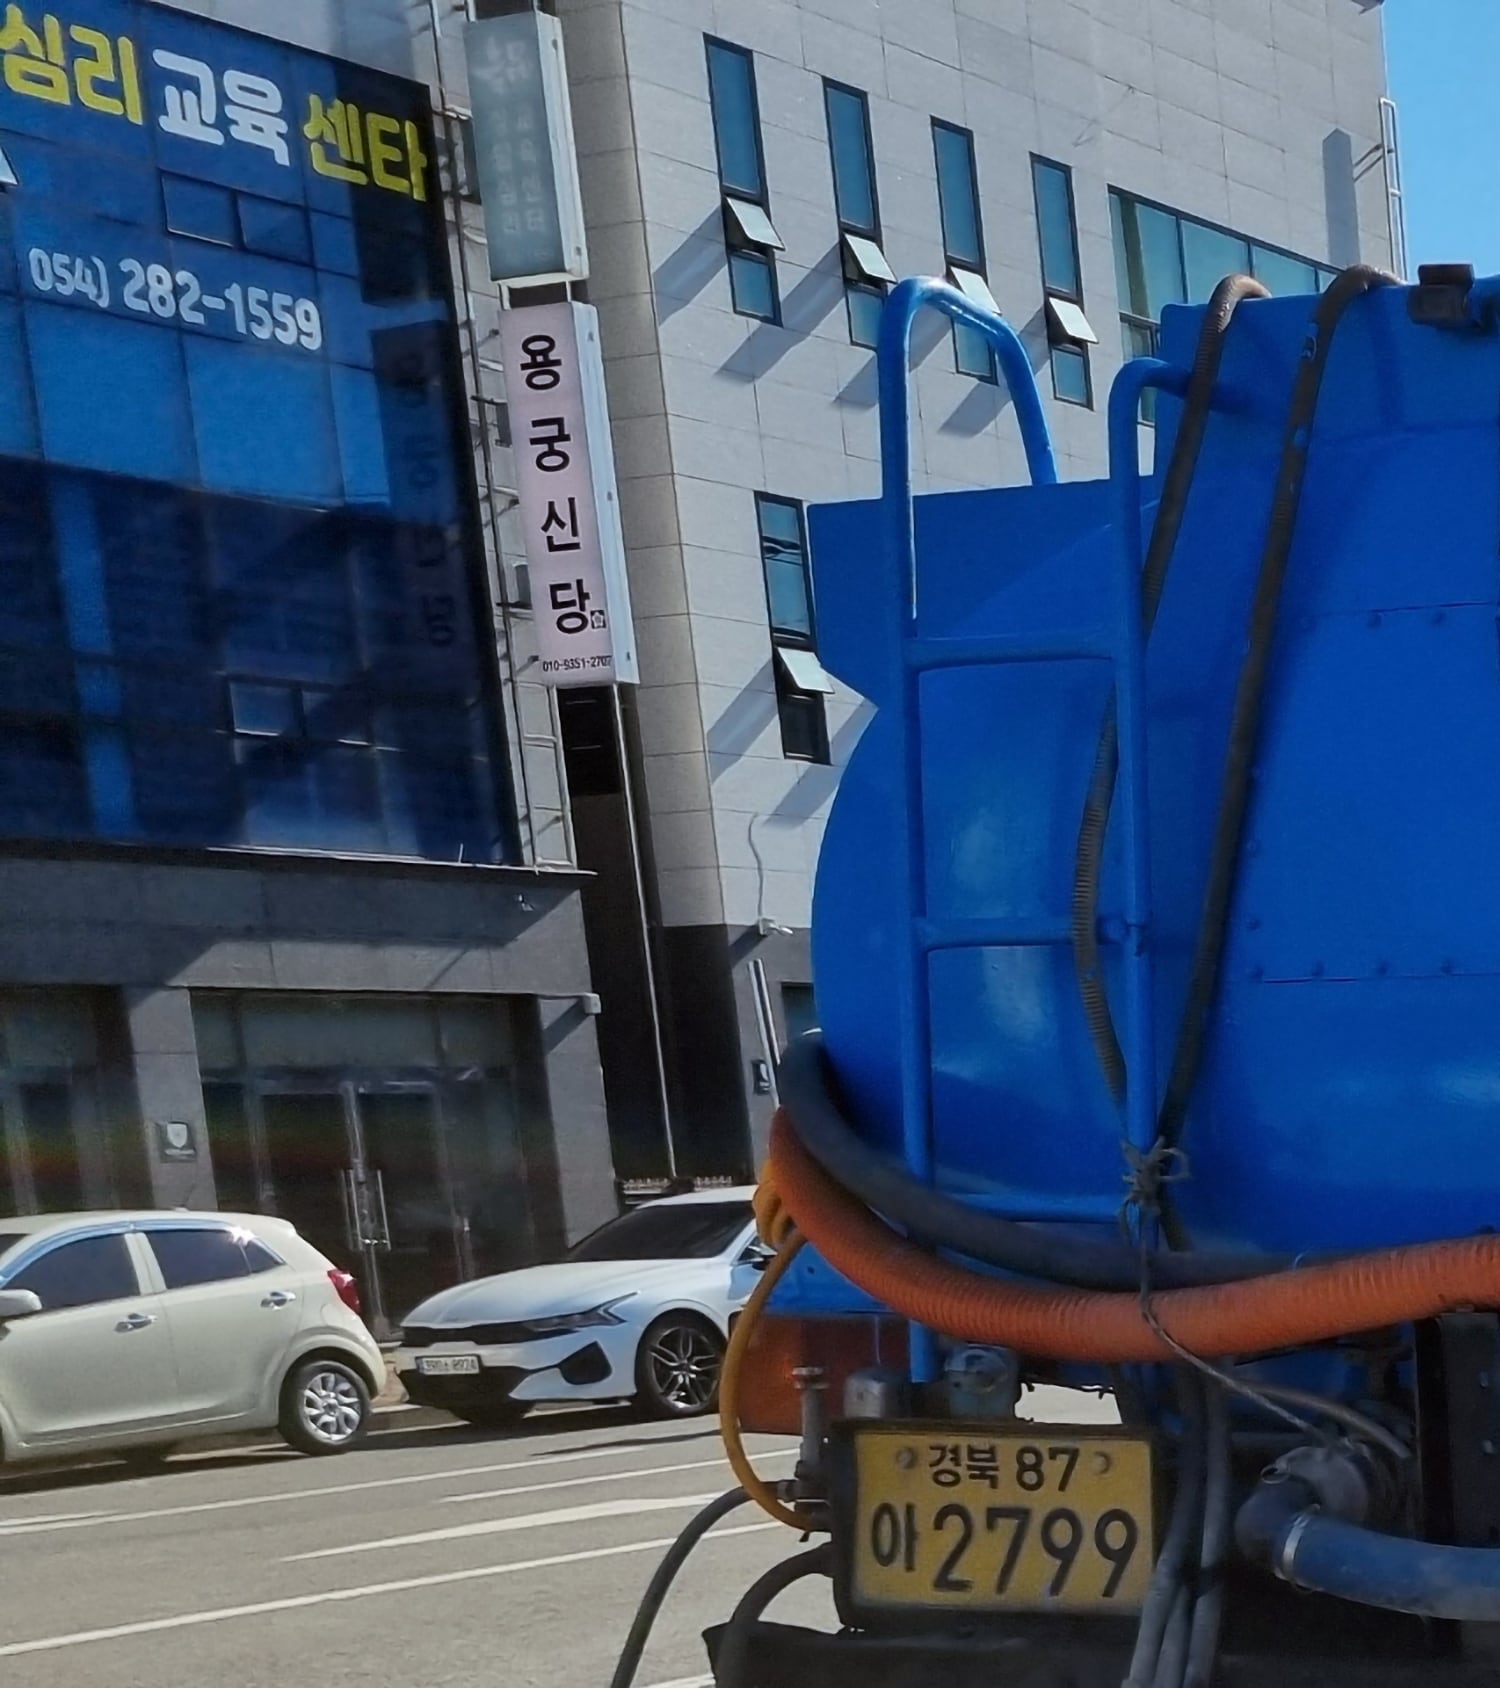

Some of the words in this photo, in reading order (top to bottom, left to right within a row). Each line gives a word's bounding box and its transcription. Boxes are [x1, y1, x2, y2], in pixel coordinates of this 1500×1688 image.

[0, 4, 143, 125] 심리
[152, 49, 291, 166] 교육
[303, 94, 427, 201] 센타
[29, 248, 110, 308] 054)
[118, 258, 322, 351] 282-1559
[519, 333, 591, 635] 용궁신당
[929, 1444, 999, 1489] 경북
[1016, 1446, 1079, 1492] 87
[871, 1502, 918, 1572] 아
[932, 1503, 1138, 1598] 2799
